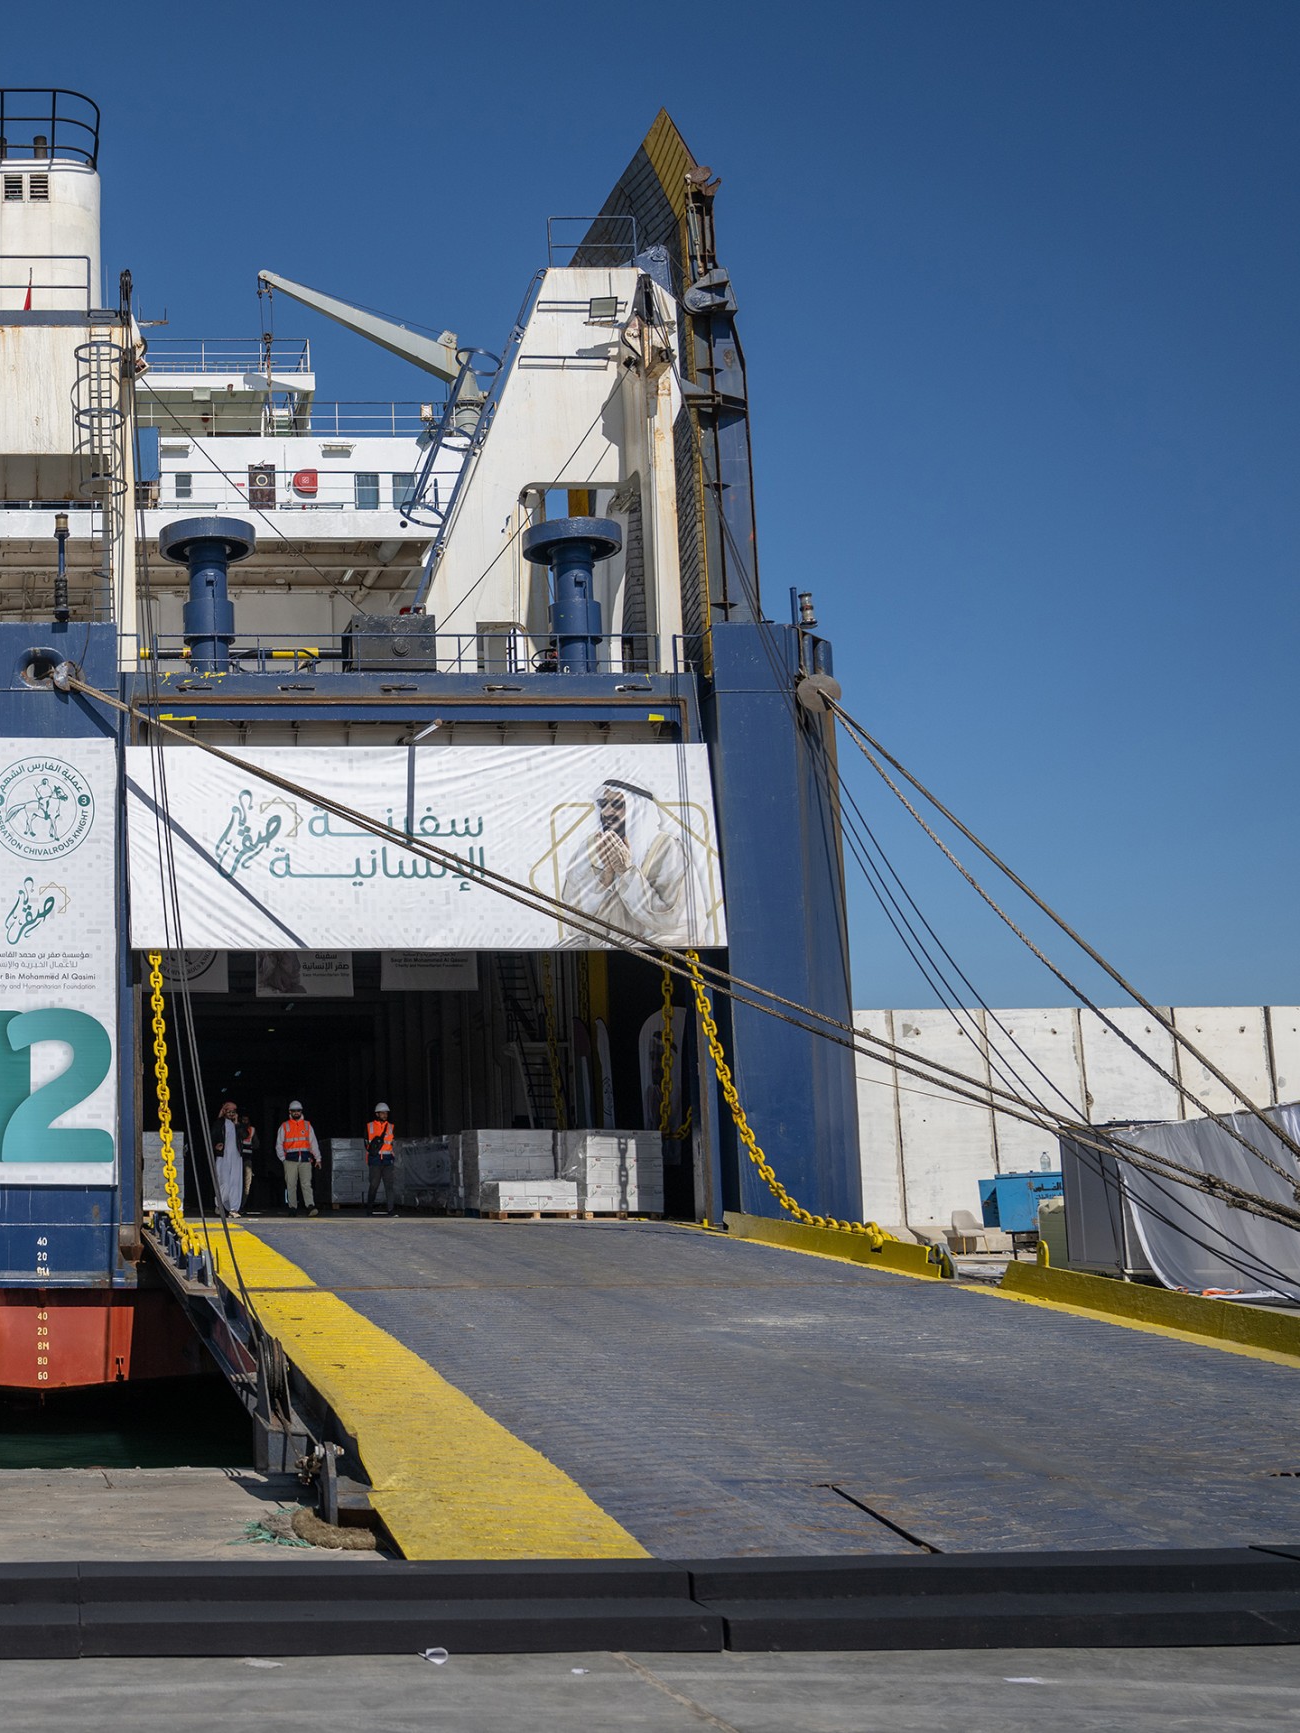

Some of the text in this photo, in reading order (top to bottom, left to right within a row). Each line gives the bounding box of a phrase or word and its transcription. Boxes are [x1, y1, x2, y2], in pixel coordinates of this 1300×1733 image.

[27, 761, 62, 774] الفارس
[61, 767, 84, 794] عملية
[308, 806, 484, 844] سفينة
[23, 838, 76, 857] CHIVALROUS
[73, 809, 89, 843] KNIGHT
[268, 846, 485, 892] الإنسانية
[315, 951, 338, 961] سفينة
[302, 961, 350, 972] صقر الإنسانية
[5, 972, 16, 980] Bin
[36, 1237, 48, 1246] 40
[36, 1252, 48, 1261] 20
[36, 1312, 48, 1321] 40
[36, 1327, 48, 1336] 20
[36, 1342, 50, 1351] 8M
[36, 1356, 48, 1366] 80
[36, 1372, 48, 1381] 60
